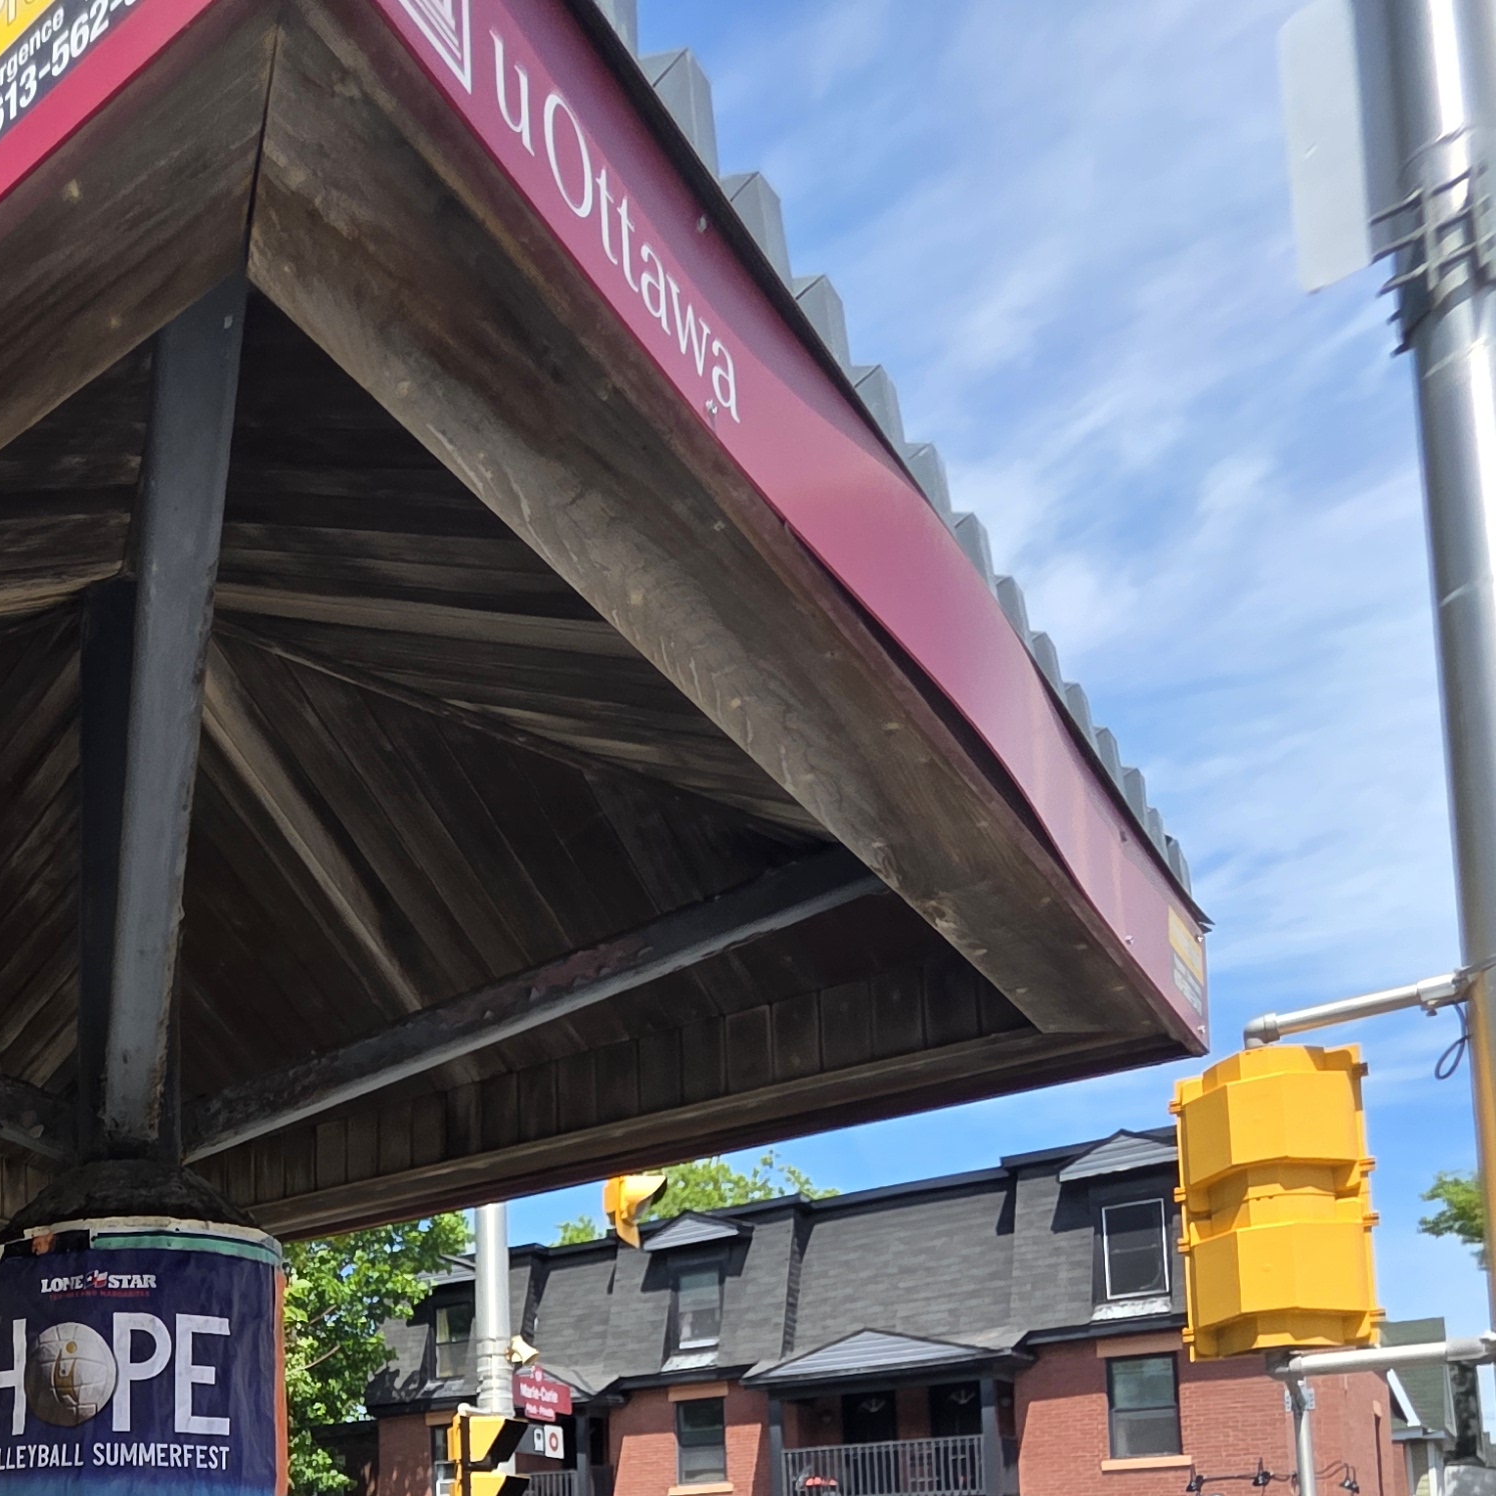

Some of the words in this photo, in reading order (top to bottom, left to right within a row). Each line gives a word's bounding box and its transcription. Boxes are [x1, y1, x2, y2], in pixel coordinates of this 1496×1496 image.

[488, 27, 741, 424] uOttawa
[40, 1275, 84, 1294] LONE
[108, 1275, 157, 1289] STAR
[92, 1442, 230, 1470] SUMMERFEST
